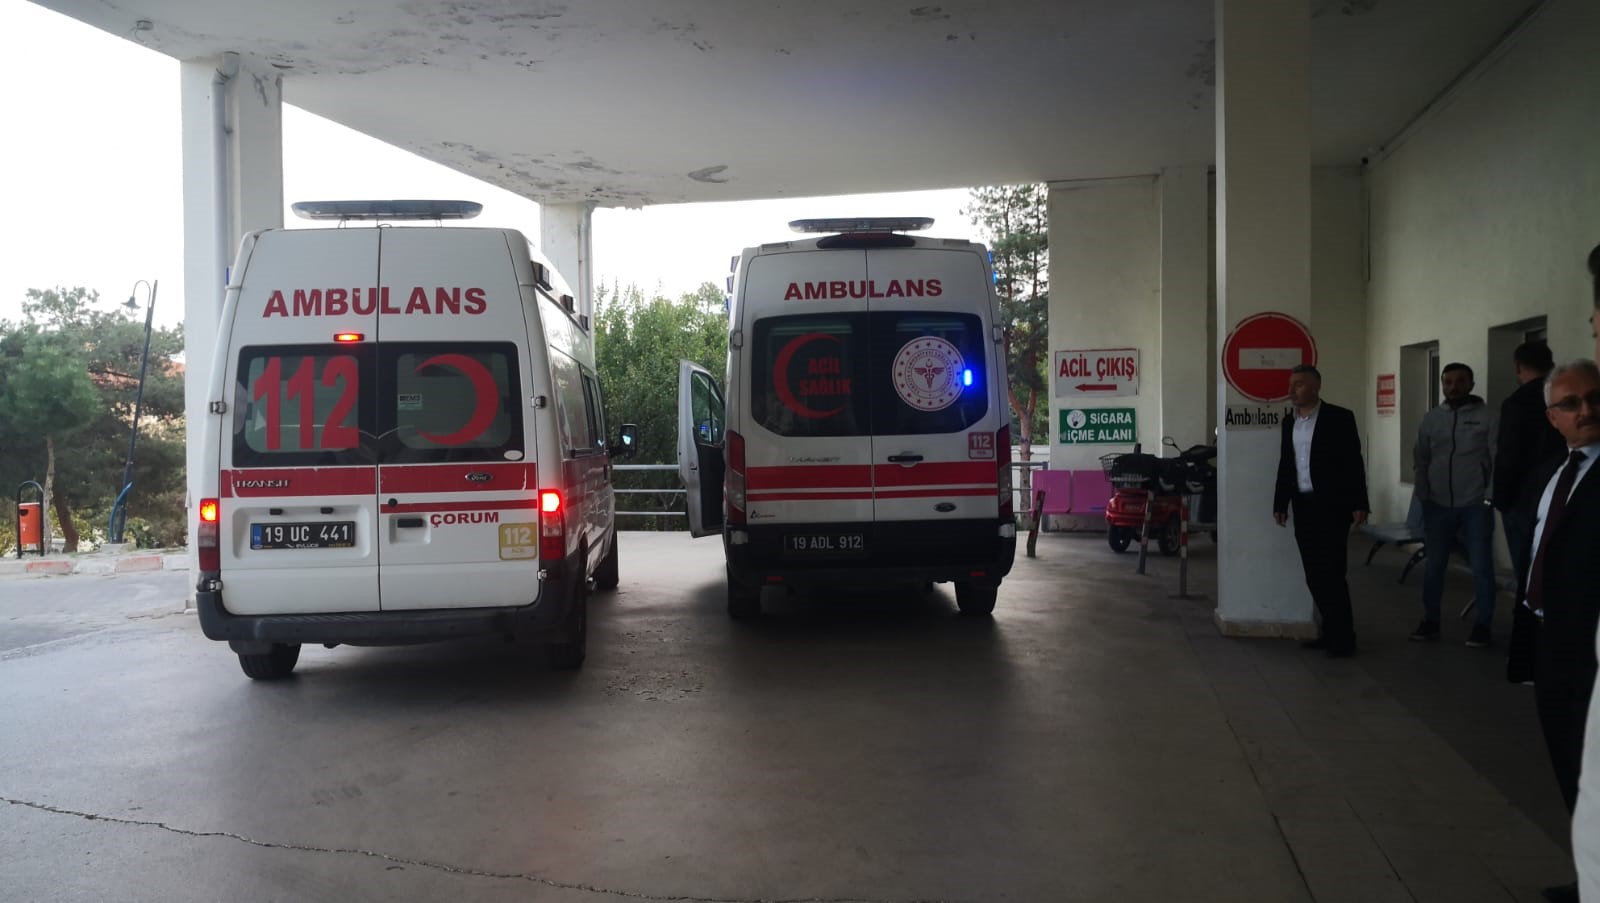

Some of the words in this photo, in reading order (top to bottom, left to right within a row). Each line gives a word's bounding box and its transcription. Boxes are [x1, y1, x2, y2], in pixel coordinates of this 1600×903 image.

[785, 279, 942, 300] AMBULANS
[262, 287, 487, 318] AMBULANS
[1059, 354, 1091, 378] ACİL
[1096, 356, 1135, 381] ÇIKIŞ
[253, 355, 359, 450] 112
[1225, 407, 1279, 425] Ambulans
[972, 434, 991, 449] 112
[1097, 429, 1132, 441] ALANI
[430, 511, 499, 528] ÇORUM
[265, 527, 284, 543] 19
[290, 525, 310, 542] UC
[320, 525, 348, 541] 441
[504, 526, 531, 545] 112
[793, 536, 806, 549] 19
[811, 535, 834, 549] ADL
[839, 535, 861, 549] 912
